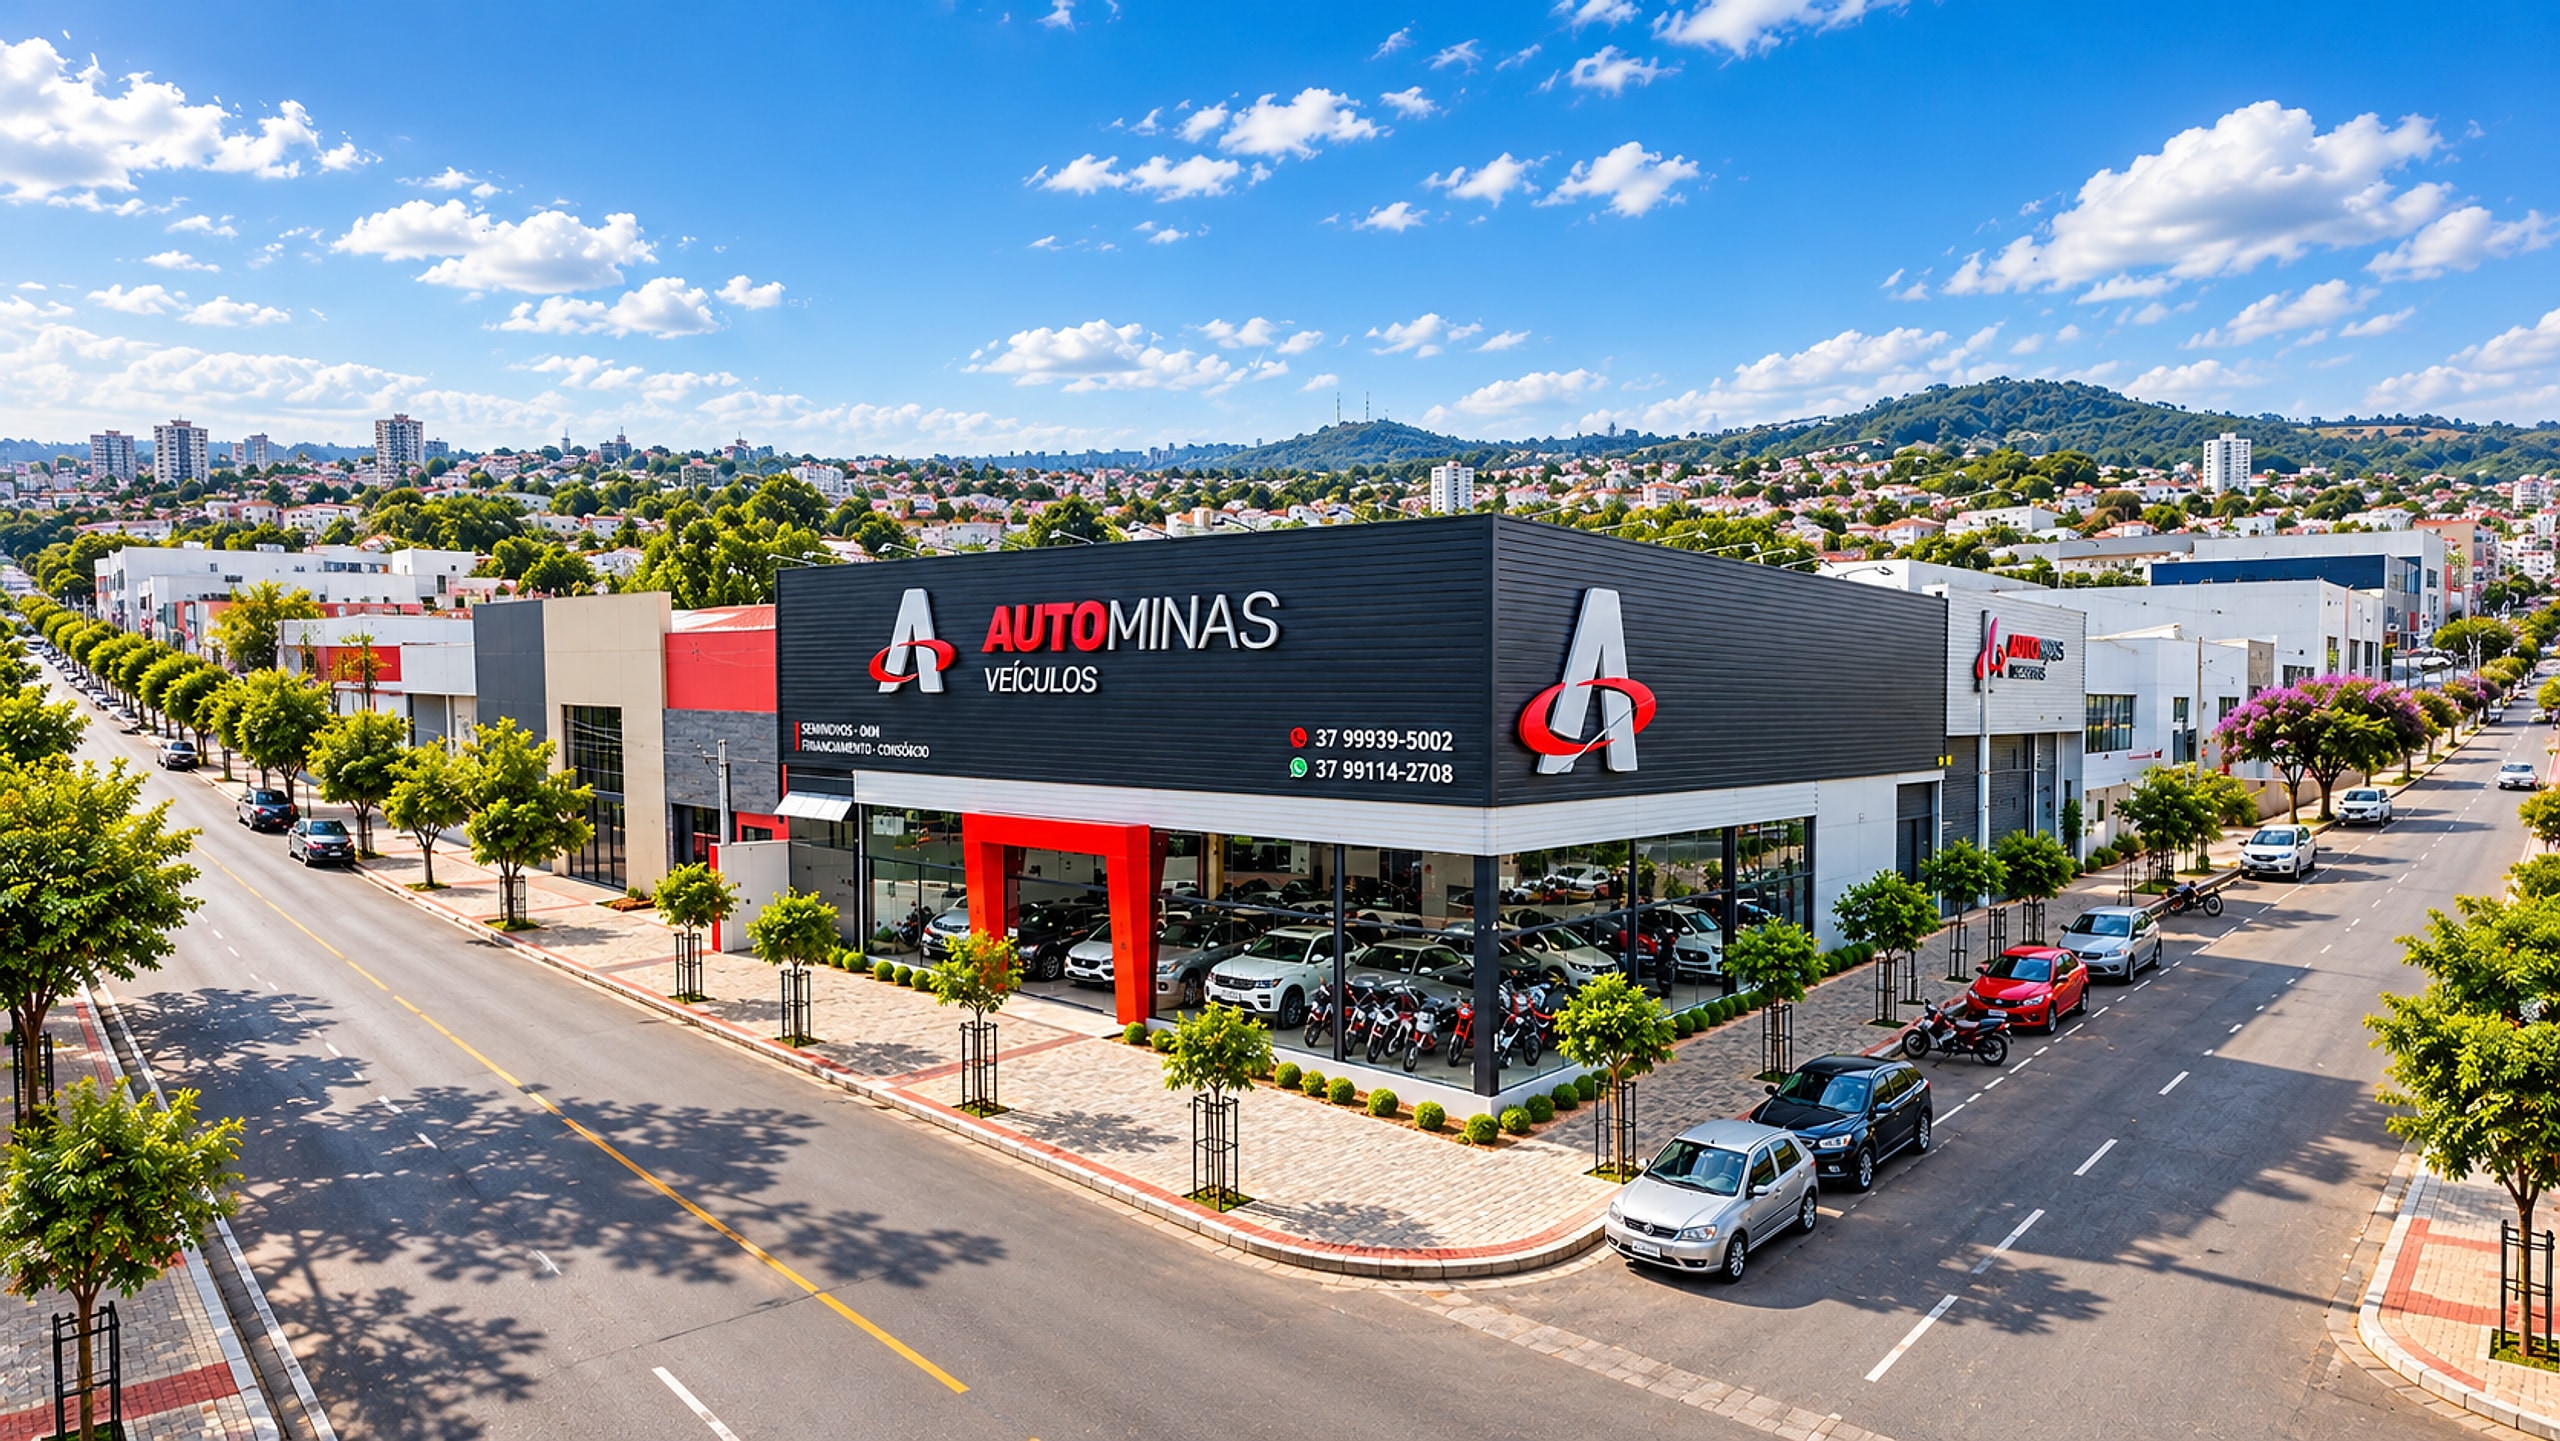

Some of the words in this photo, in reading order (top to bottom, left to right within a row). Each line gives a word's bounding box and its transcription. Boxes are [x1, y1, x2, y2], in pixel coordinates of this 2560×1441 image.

[981, 590, 1281, 653] AUTOMINAS
[984, 660, 1098, 694] VEÍCULOS
[1315, 729, 1338, 747] 37
[1343, 729, 1454, 752] 99939-5002
[1315, 760, 1338, 779] 37
[1343, 760, 1454, 784] 99114-2708
